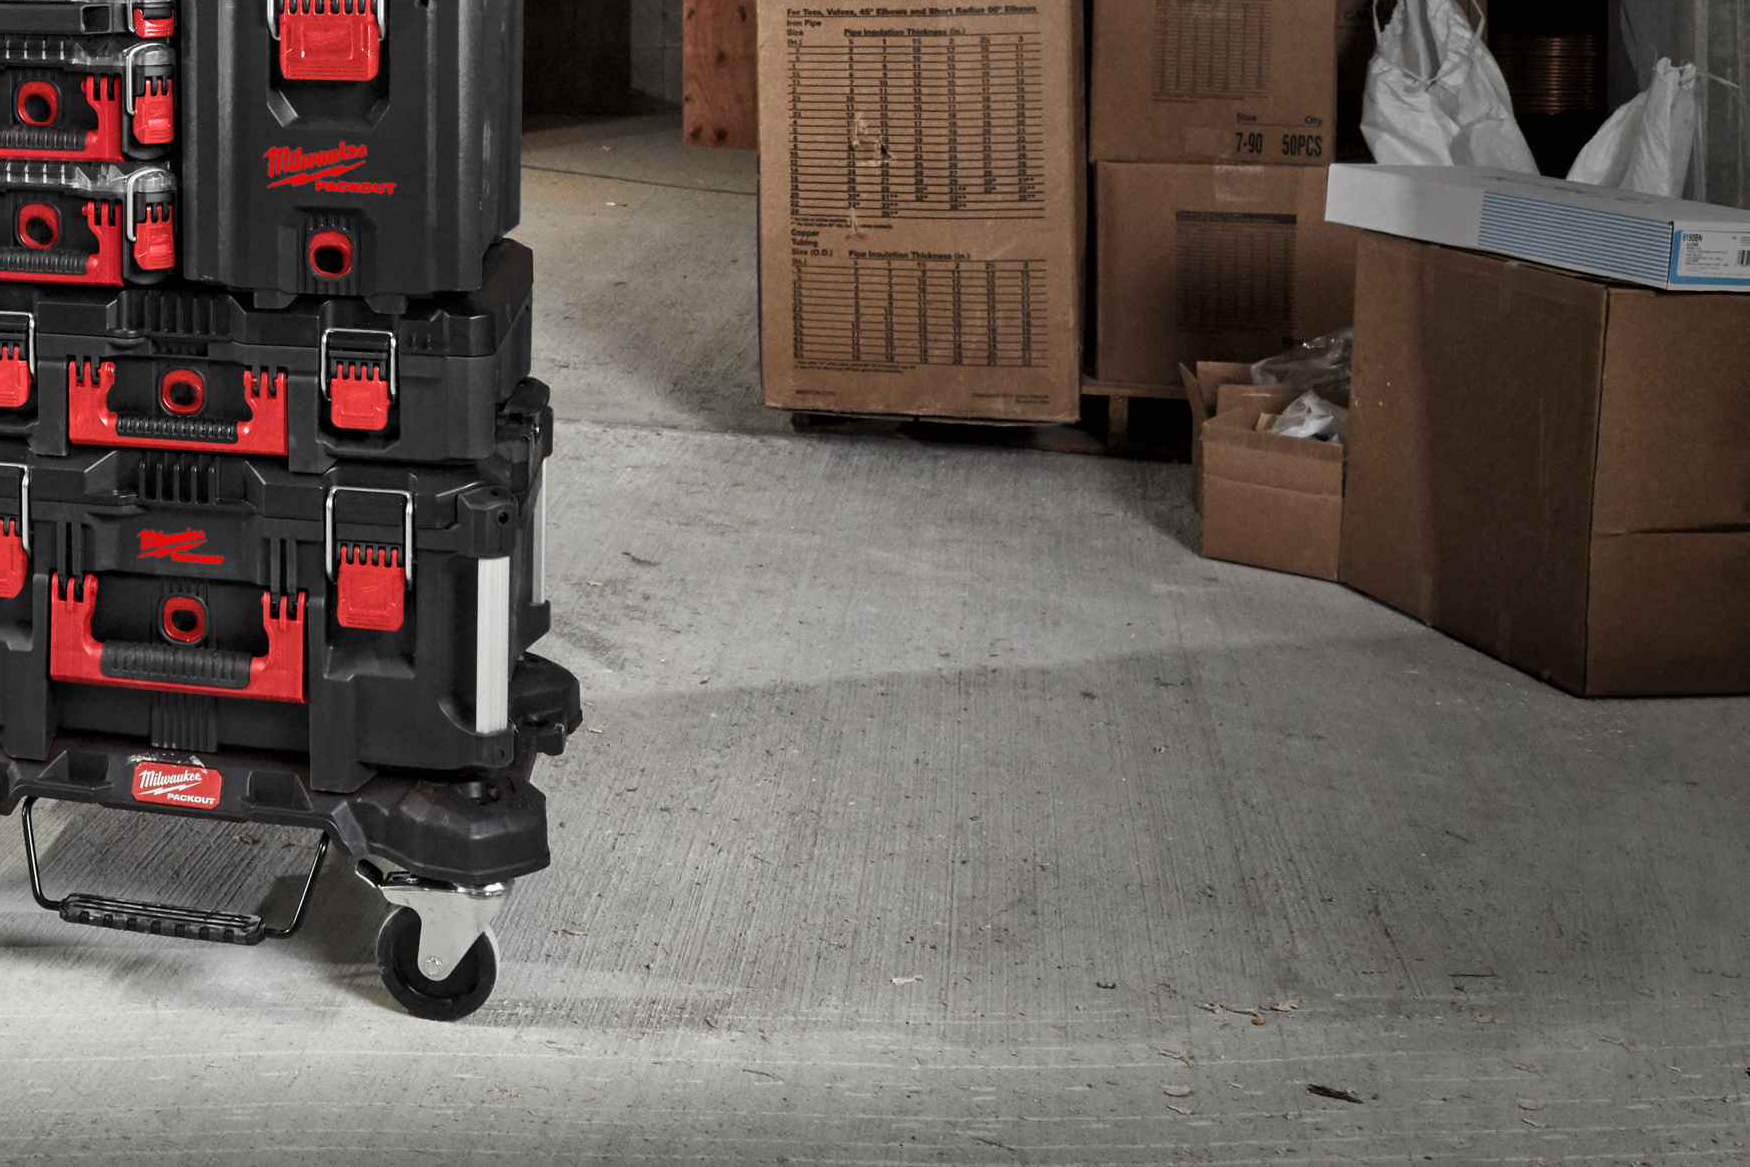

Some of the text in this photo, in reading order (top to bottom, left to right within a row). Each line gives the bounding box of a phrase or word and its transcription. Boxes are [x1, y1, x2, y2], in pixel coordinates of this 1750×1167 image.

[910, 7, 926, 15] and
[929, 7, 953, 15] Short
[956, 6, 985, 14] Radius
[1005, 5, 1037, 13] Elbows
[804, 20, 822, 28] Pipe
[844, 29, 862, 37] Pipe
[864, 28, 904, 36] Insulation
[906, 28, 947, 36] Thickness
[1236, 112, 1323, 128] Size Qty
[1236, 132, 1322, 158] 7-90 50PCS
[262, 141, 368, 178] Milwaukee
[315, 180, 396, 195] PACKOUT
[791, 228, 820, 237] Copper
[791, 238, 818, 248] Tubing
[791, 248, 808, 256] Size
[849, 250, 866, 259] Pipe
[868, 250, 909, 259] Insulation
[911, 252, 952, 260] Thickness
[136, 528, 206, 552] Milwaukee
[172, 553, 224, 565] PACKOUT
[138, 769, 202, 789] Milwaukee
[167, 793, 216, 805] PACKOUT
